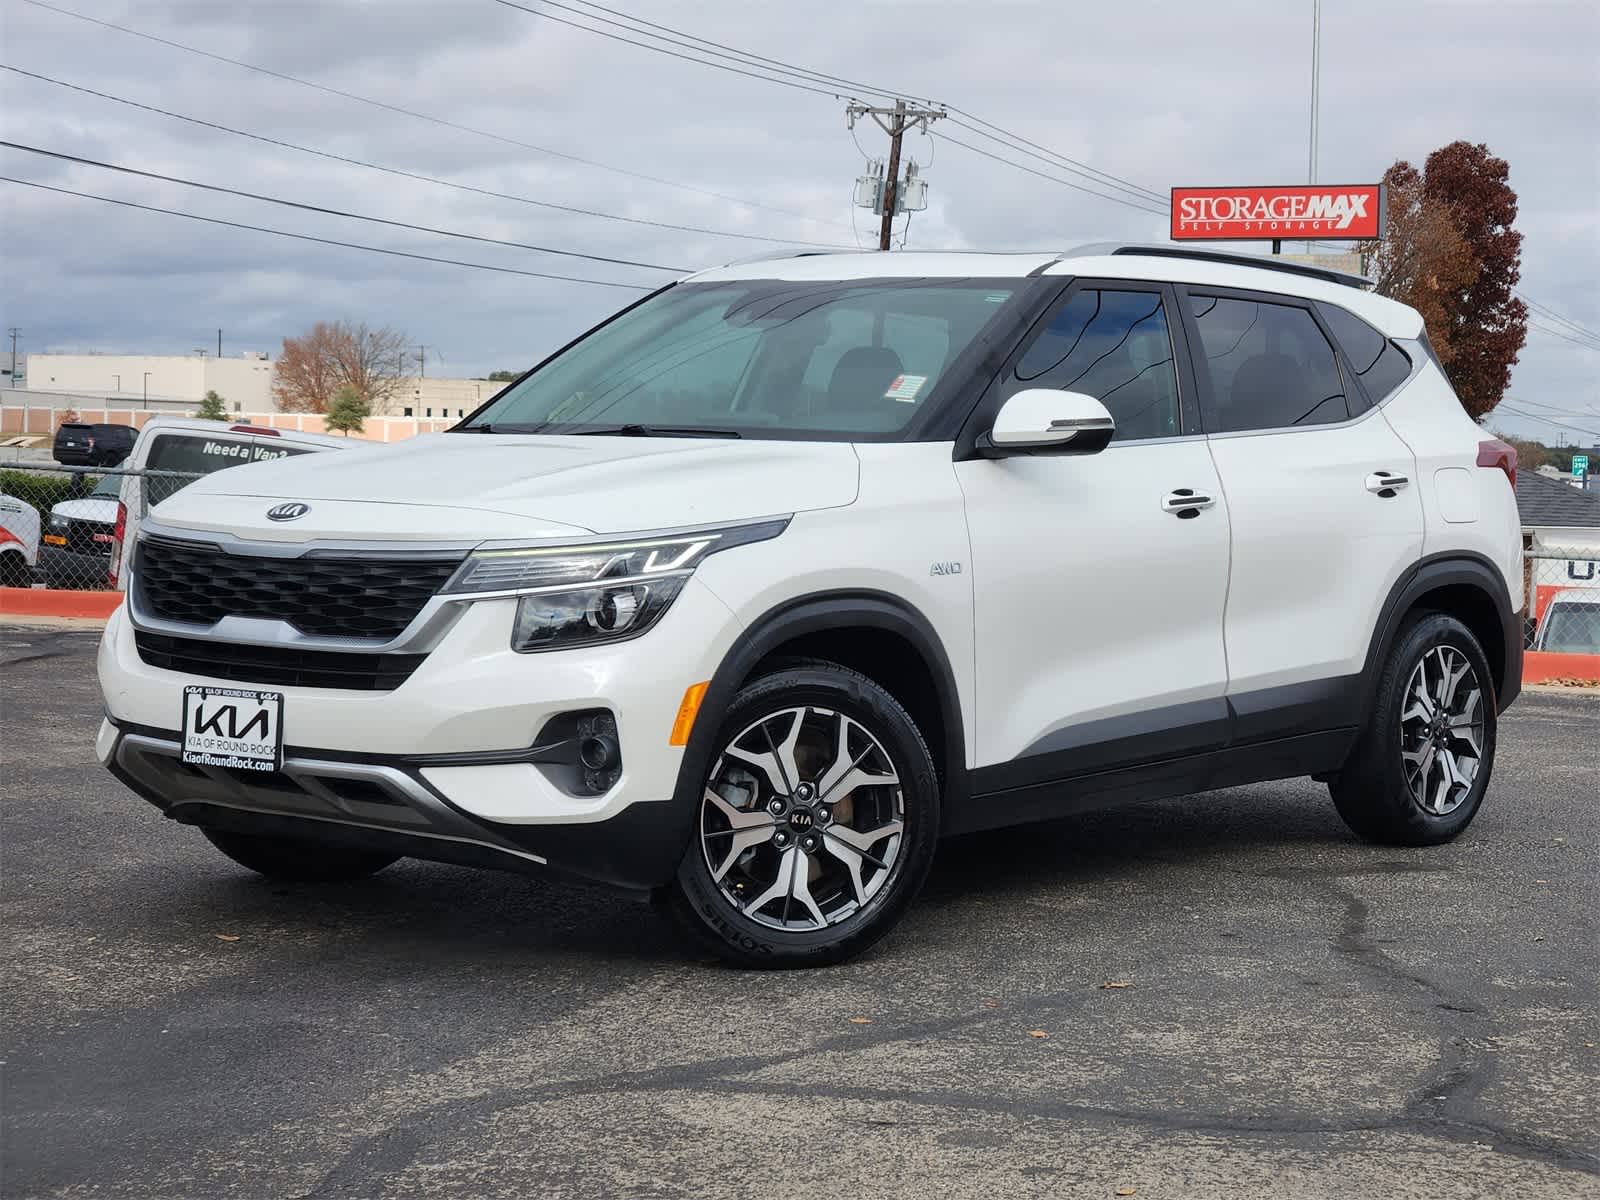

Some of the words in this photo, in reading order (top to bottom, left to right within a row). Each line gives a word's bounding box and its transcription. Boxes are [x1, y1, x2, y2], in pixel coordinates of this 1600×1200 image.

[1180, 222, 1224, 231] SELF
[1245, 221, 1333, 231] STORAGE
[203, 441, 240, 456] Need
[240, 448, 250, 458] a
[930, 561, 962, 577] AWD
[185, 686, 203, 694] KIA
[215, 688, 222, 696] OF
[222, 689, 242, 698] ROUND
[195, 704, 268, 740] KIA
[187, 735, 202, 747] KIA
[203, 738, 215, 748] OF
[217, 740, 249, 753] ROUND
[250, 743, 275, 756] ROCK
[183, 751, 274, 772] KiaofRoundRock.com
[791, 814, 812, 825] KIA
